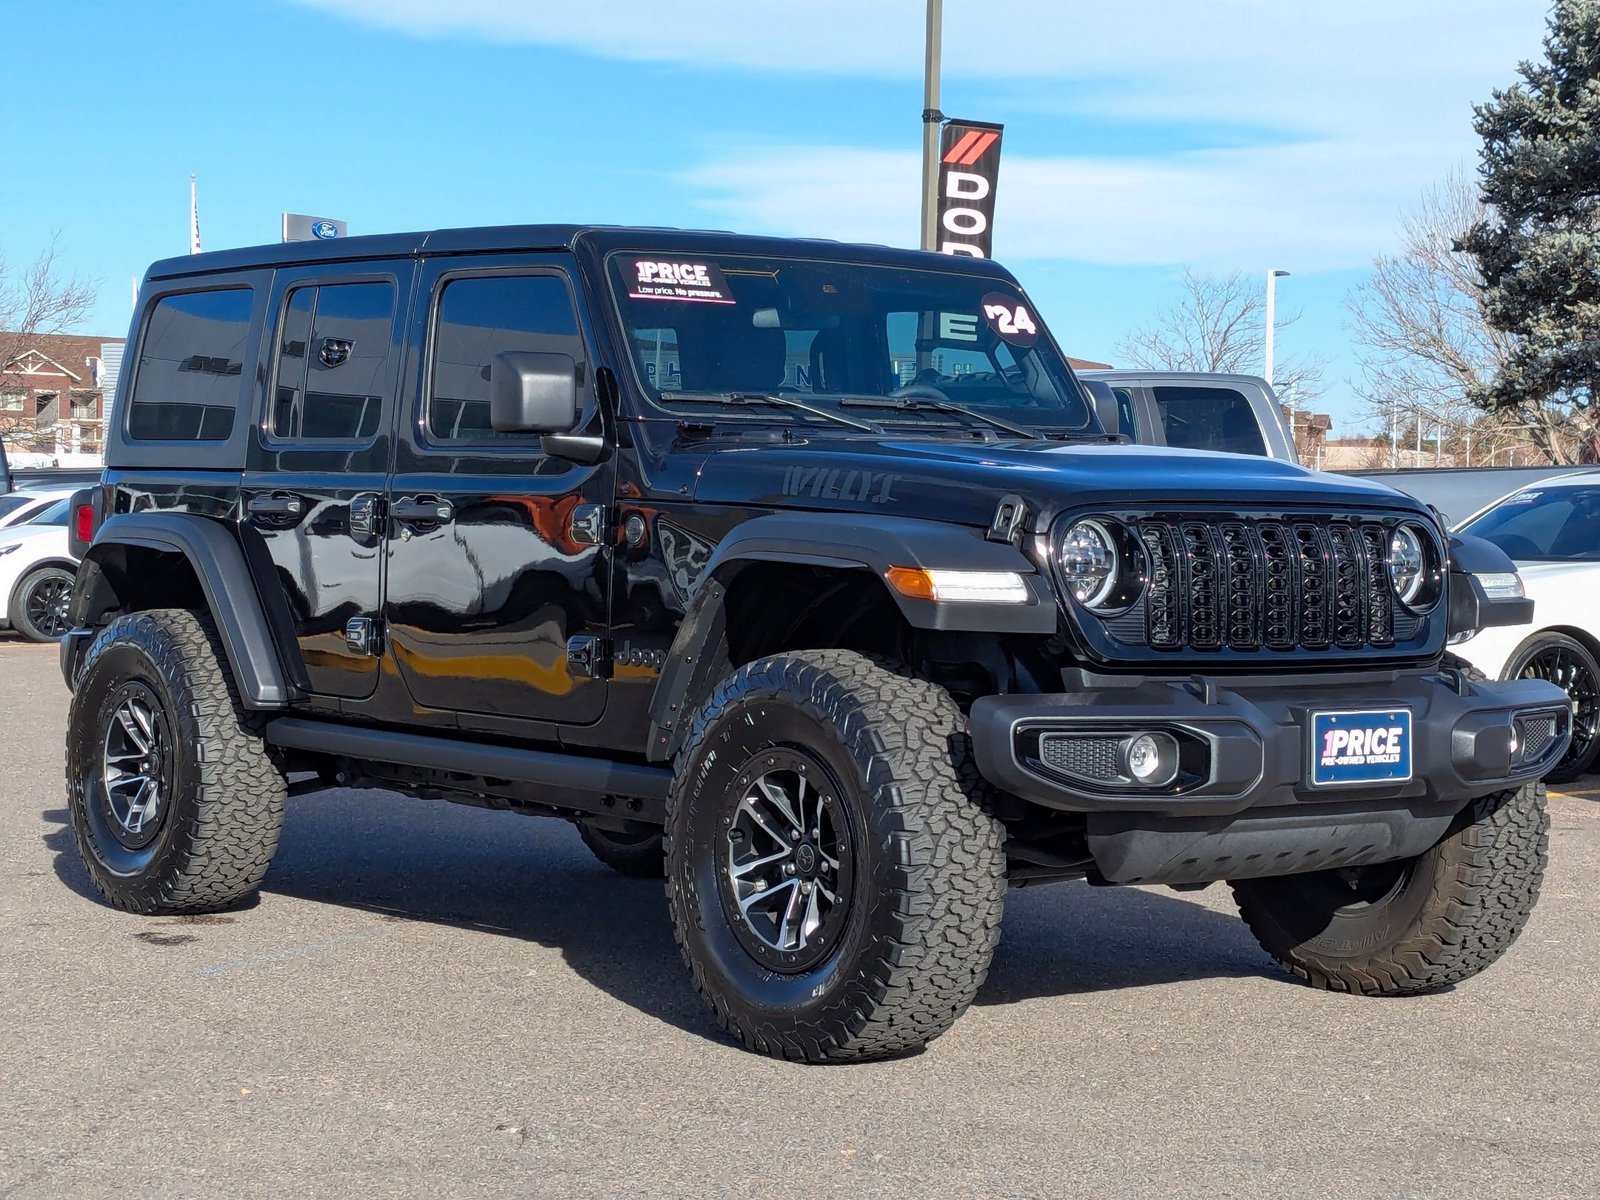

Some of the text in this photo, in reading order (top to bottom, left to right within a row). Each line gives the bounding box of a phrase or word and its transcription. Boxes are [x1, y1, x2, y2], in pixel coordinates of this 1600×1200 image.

[635, 261, 710, 281] 1PRICE
[638, 285, 722, 298] Low price. No pressure.
[984, 305, 1036, 334] '24
[782, 465, 903, 504] WILLYS
[614, 640, 667, 673] Jeep
[1323, 727, 1403, 757] 1PRICE
